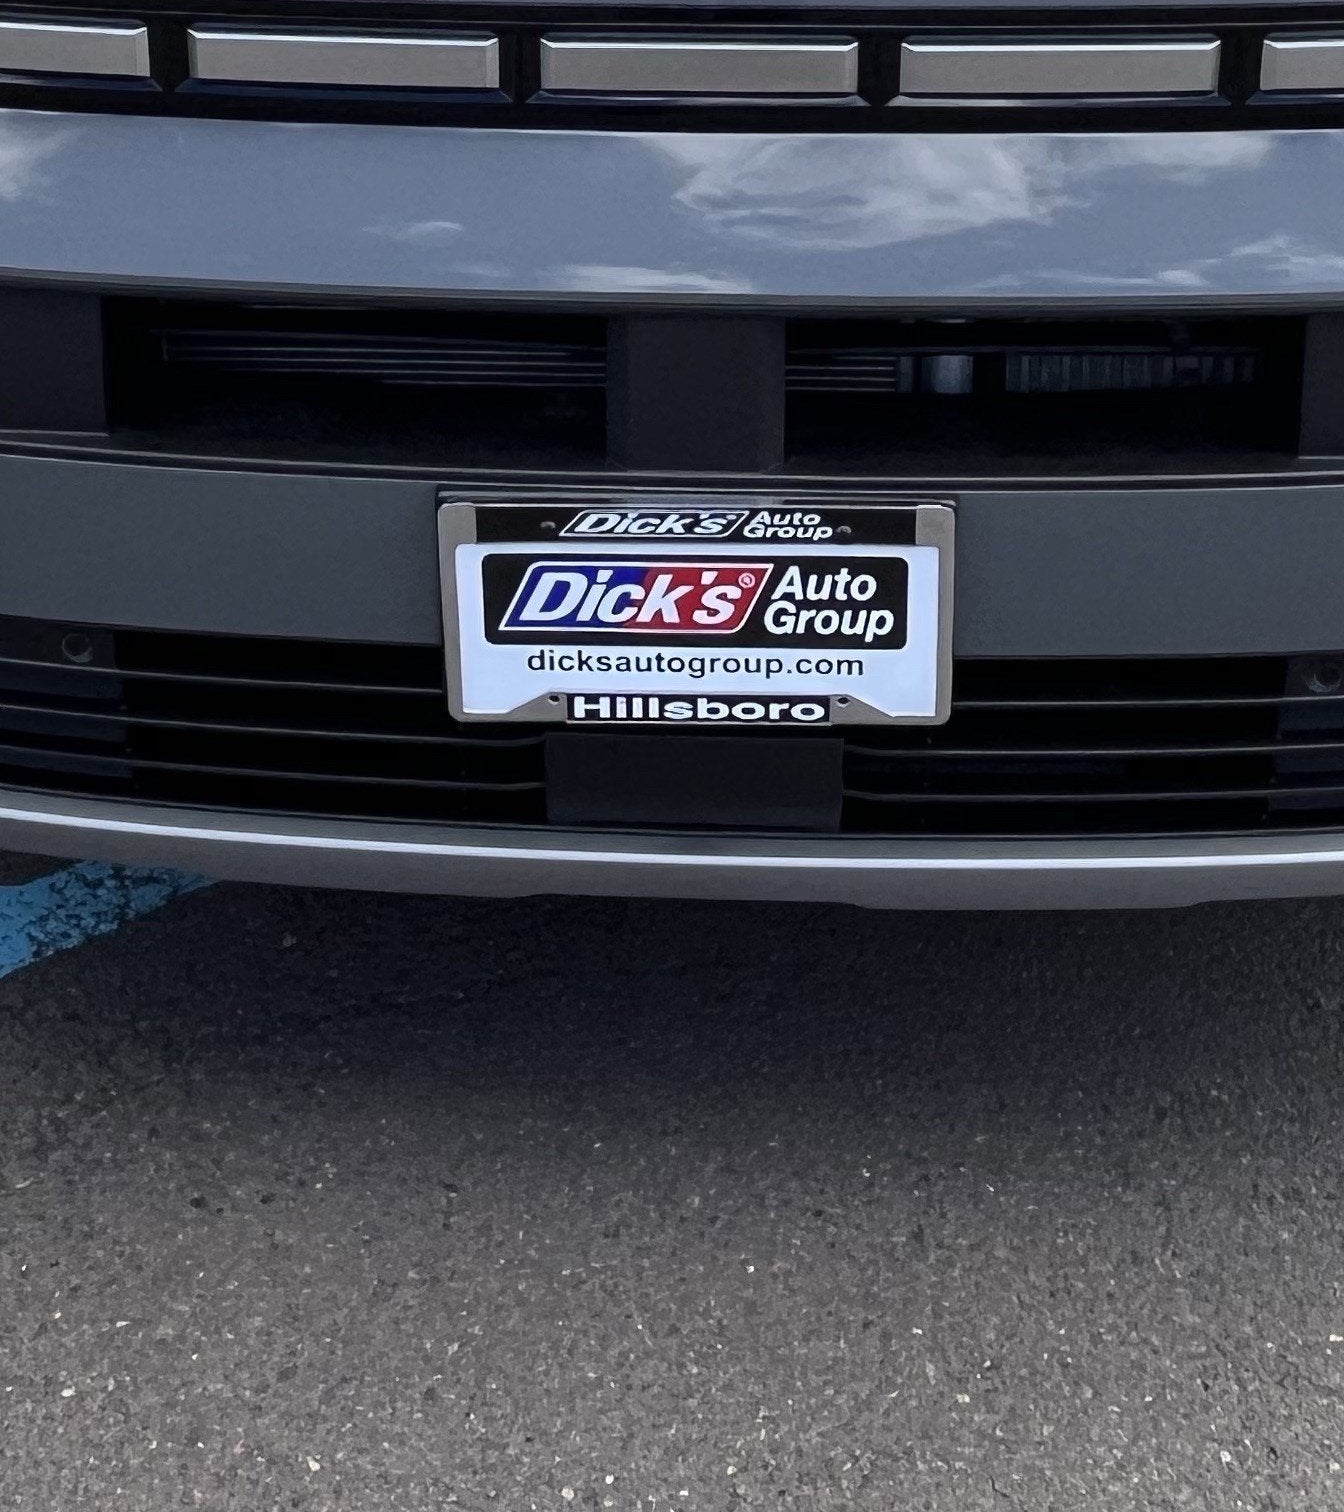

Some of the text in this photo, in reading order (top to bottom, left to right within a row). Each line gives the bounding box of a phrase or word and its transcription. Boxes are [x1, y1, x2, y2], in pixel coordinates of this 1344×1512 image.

[754, 510, 822, 525] Auto
[742, 524, 834, 541] Group
[771, 566, 877, 601] Auto
[763, 601, 895, 643] Group
[527, 650, 864, 678] dicksautogroup.com
[573, 696, 826, 721] Hillsboro
